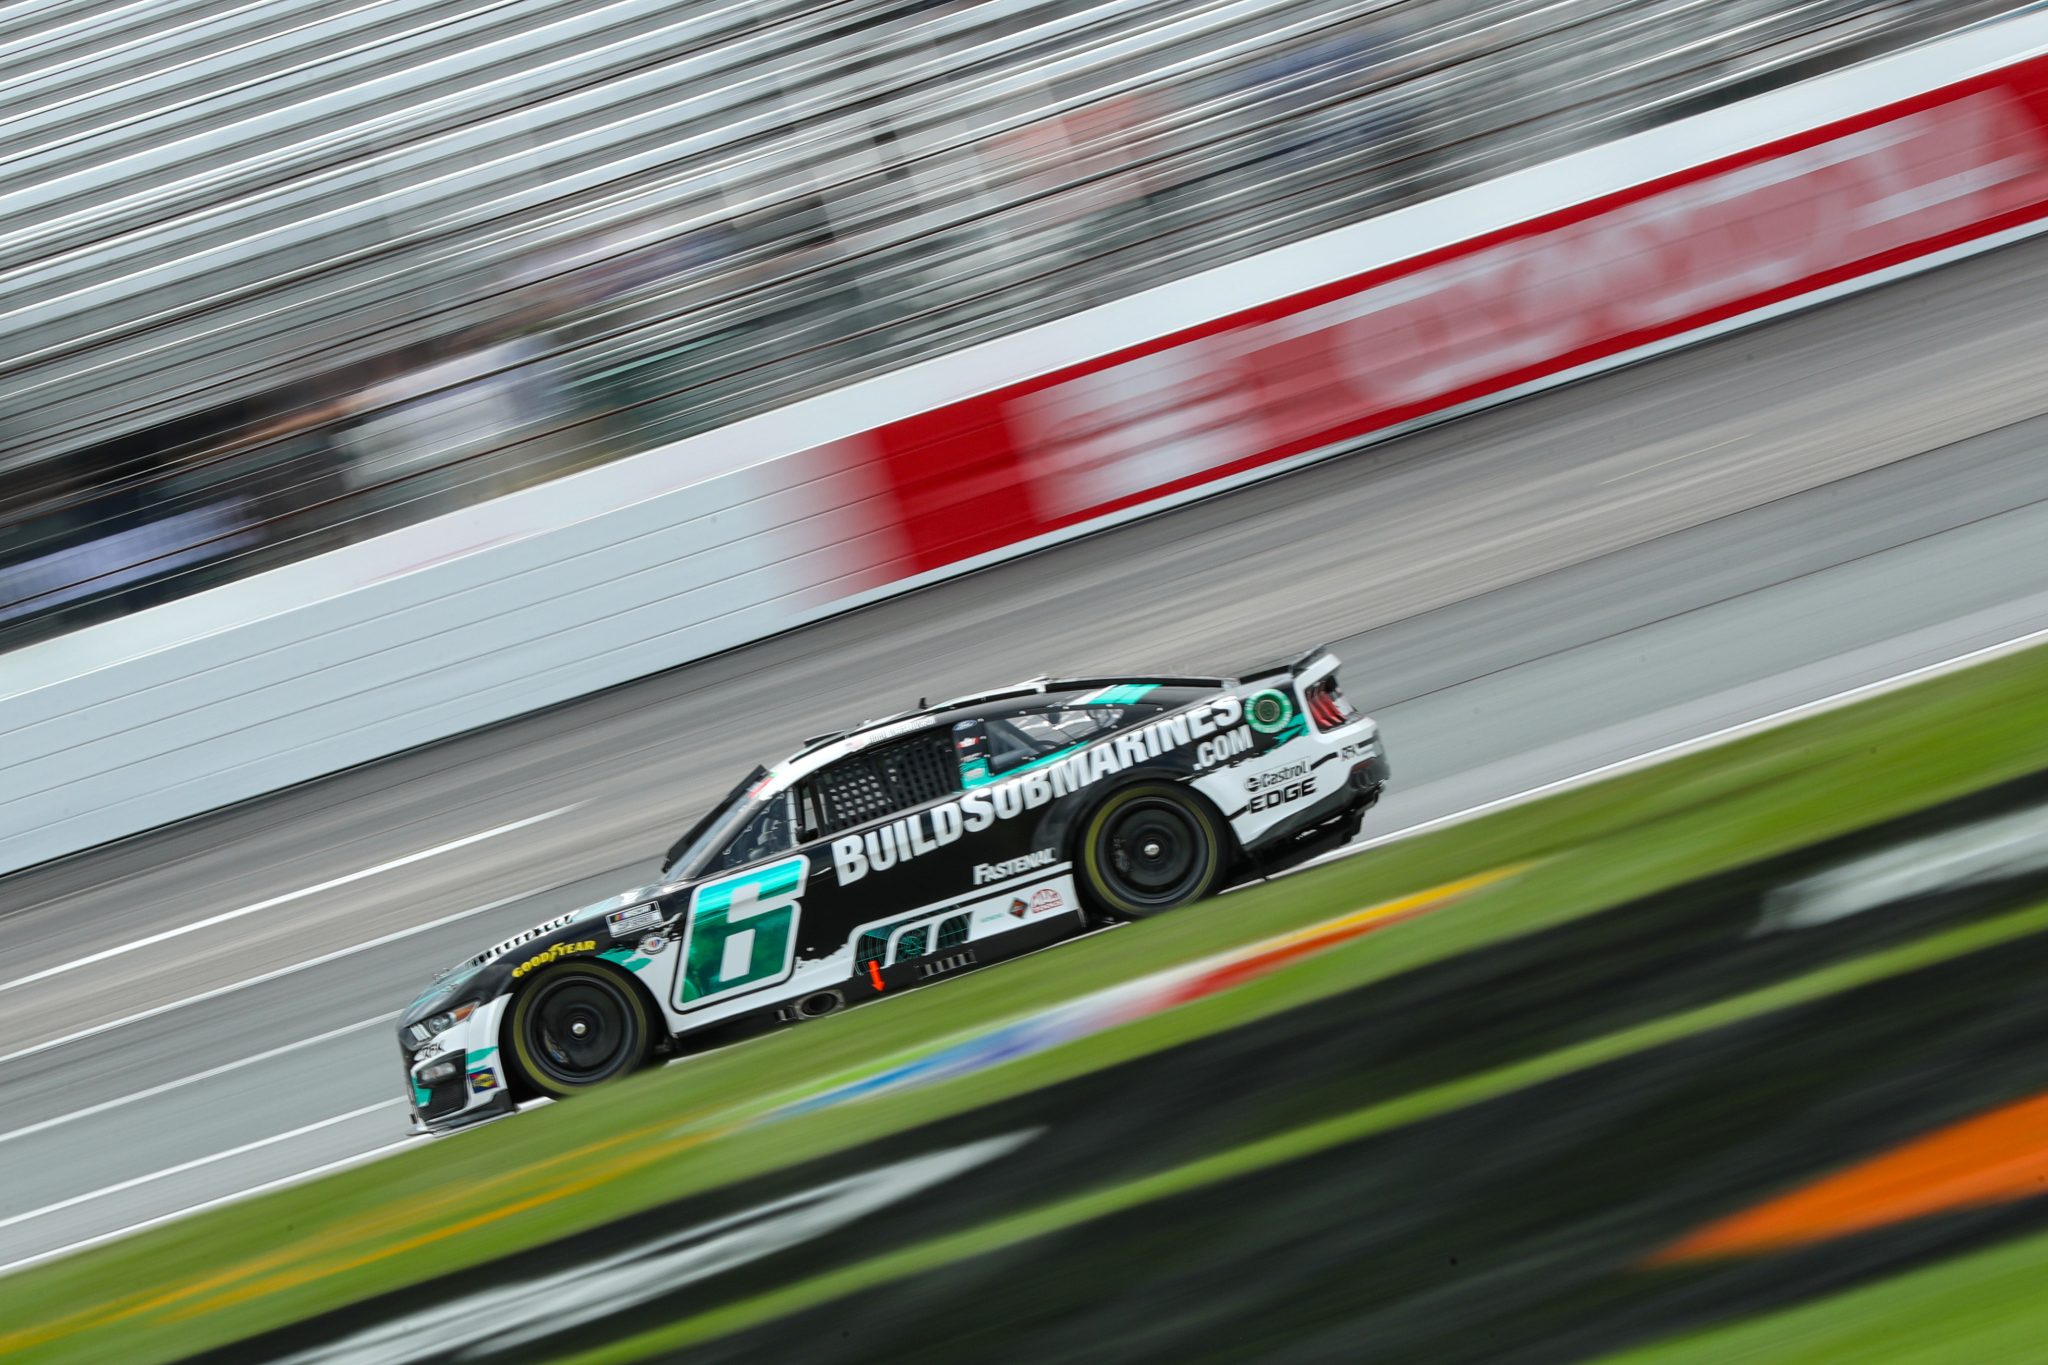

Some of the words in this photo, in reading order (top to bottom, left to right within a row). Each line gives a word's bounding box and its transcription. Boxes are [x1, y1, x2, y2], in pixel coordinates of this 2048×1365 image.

[1194, 725, 1254, 771] .COM
[831, 696, 1242, 887] BUILDSUBMARINES
[1249, 777, 1318, 814] EDGE
[1260, 761, 1309, 788] Castrol
[677, 856, 808, 1008] 6
[511, 940, 597, 978] GOODYEAR
